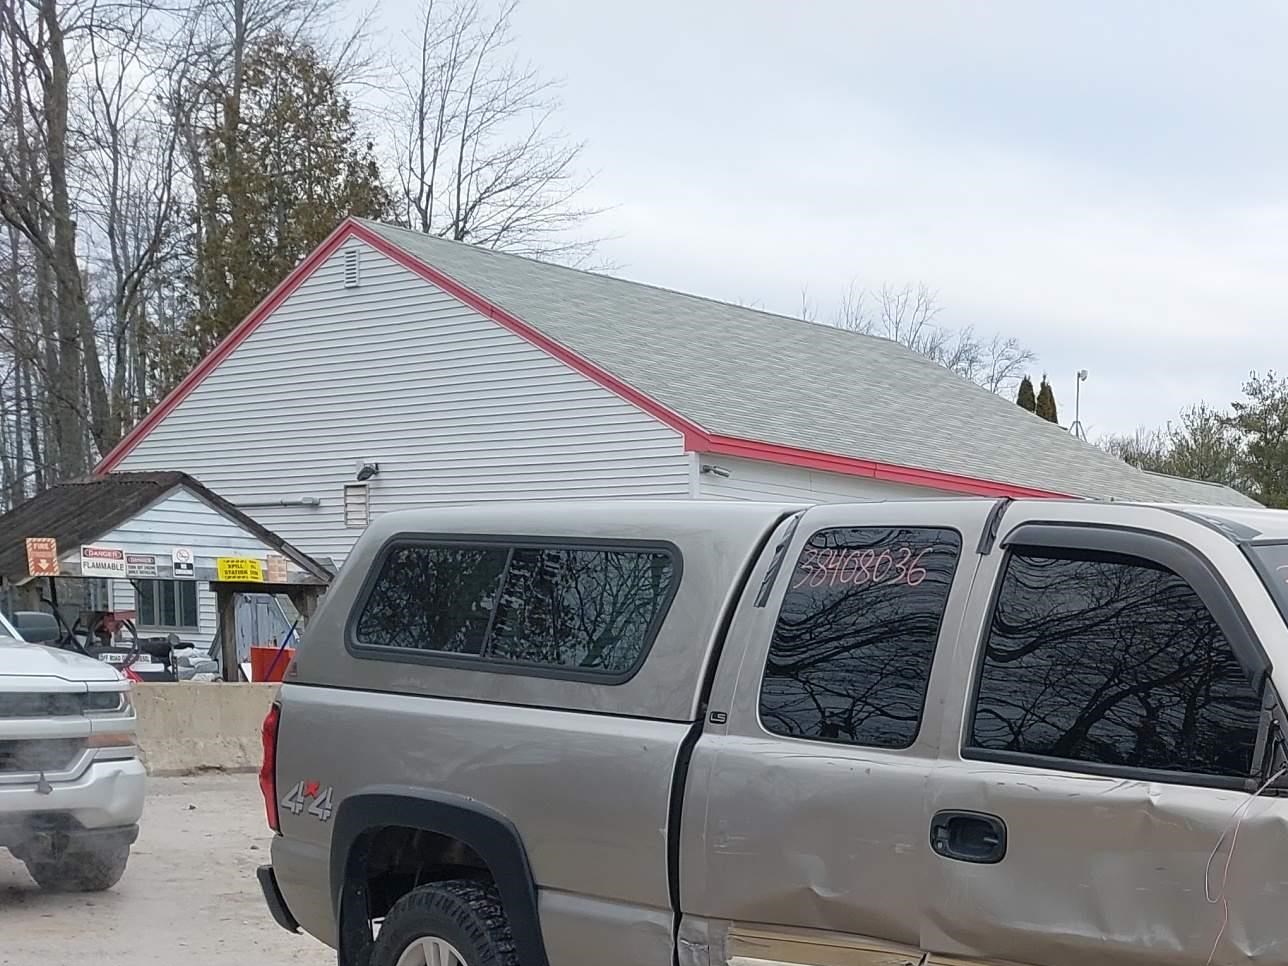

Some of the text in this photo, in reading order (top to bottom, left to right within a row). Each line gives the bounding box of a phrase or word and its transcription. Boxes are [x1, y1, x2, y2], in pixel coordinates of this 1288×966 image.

[88, 549, 119, 559] DANGER
[83, 561, 124, 571] FLAMMABLE
[792, 546, 933, 589] 38408036
[710, 712, 726, 723] LS
